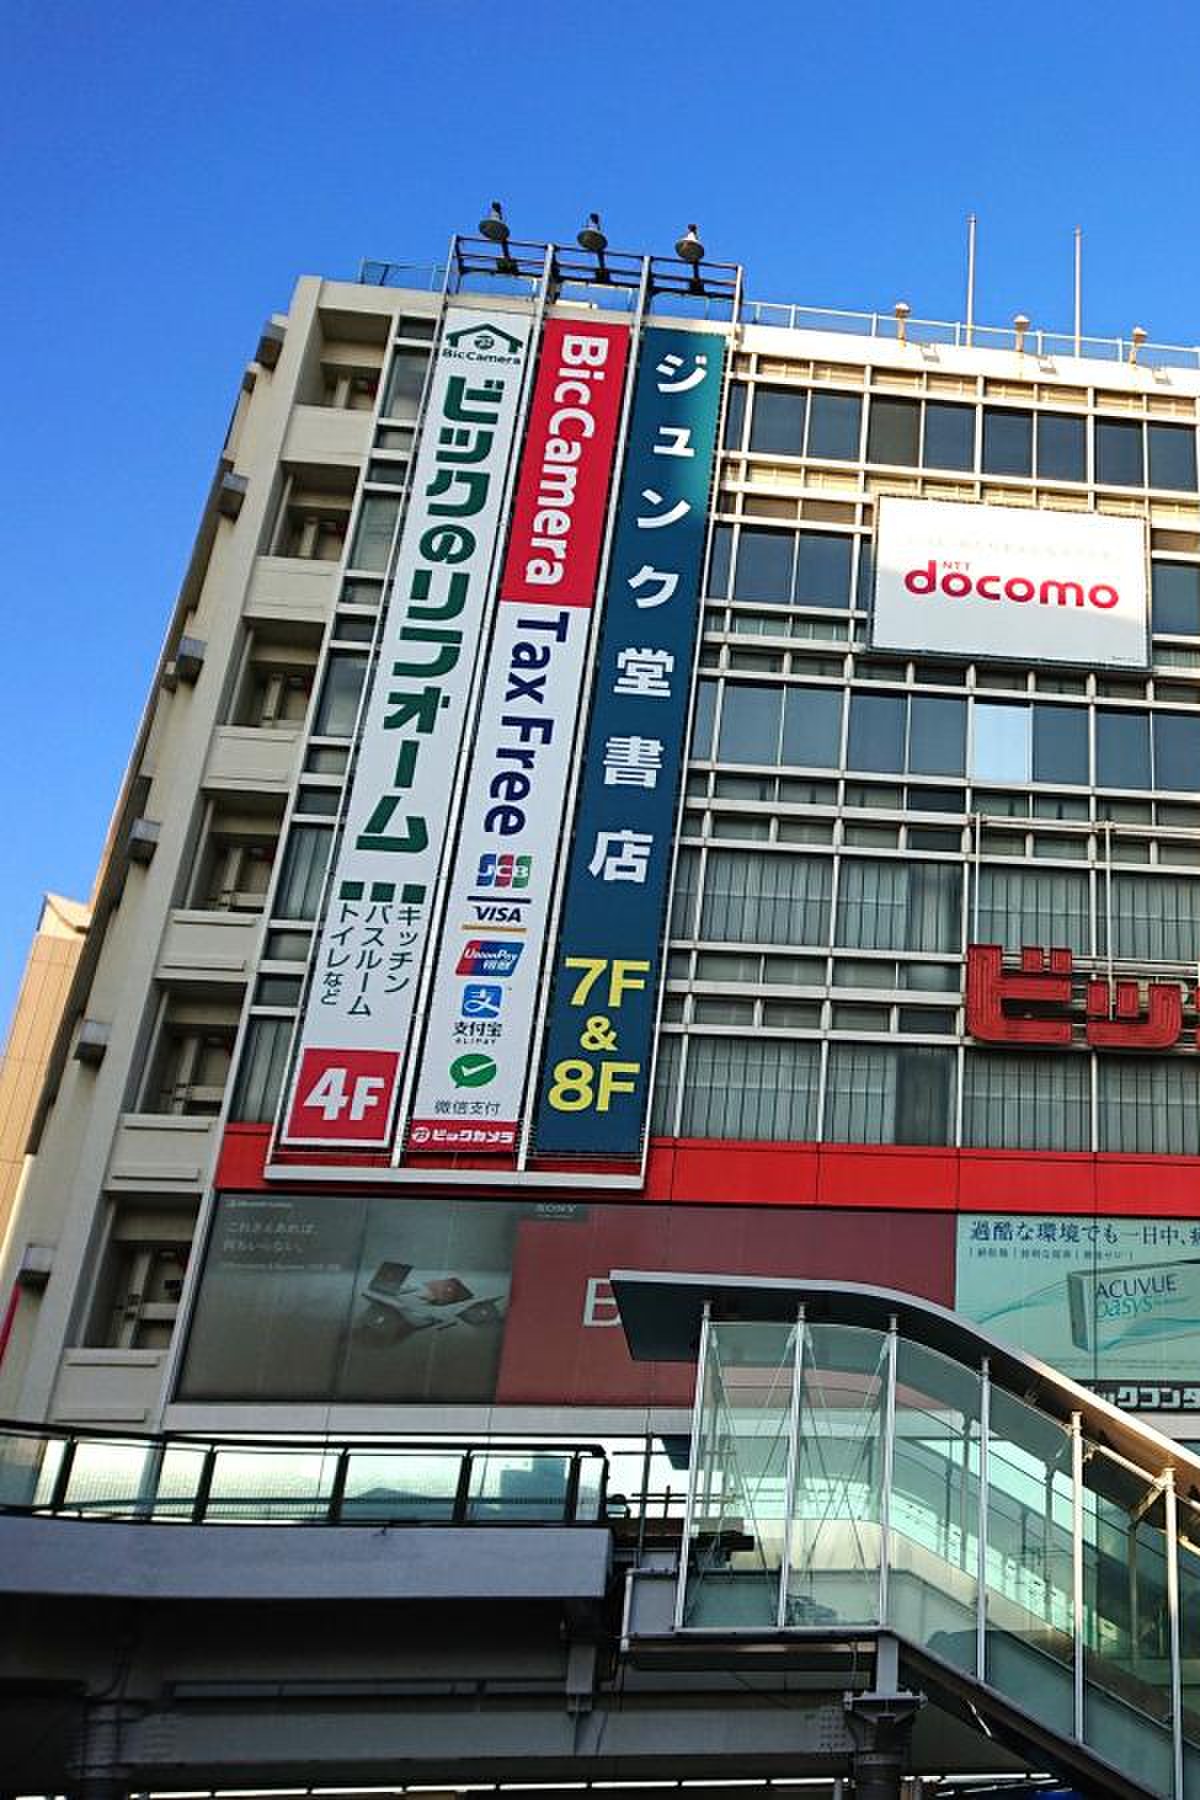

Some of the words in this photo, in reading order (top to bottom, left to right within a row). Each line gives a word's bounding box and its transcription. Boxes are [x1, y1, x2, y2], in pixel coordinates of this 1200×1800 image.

[441, 347, 522, 366] BicCamera
[524, 334, 609, 588] BicCamera
[904, 560, 1120, 609] docomo
[942, 560, 971, 571] NTT
[588, 352, 707, 883] ジュンク堂書店
[505, 611, 571, 706] Tax
[484, 714, 555, 836] Free
[472, 905, 522, 923] VISA
[320, 902, 359, 1006] トイレなど
[347, 904, 393, 1017] バスルーム
[383, 905, 422, 994] キッチン
[564, 956, 651, 1009] 7F
[580, 1014, 618, 1052] &
[303, 1067, 385, 1122] 4F
[434, 1100, 501, 1116] 微信支付
[547, 1059, 641, 1113] 8F
[431, 1127, 516, 1144] ビックカメラ
[1096, 1273, 1178, 1299] ACUVUE
